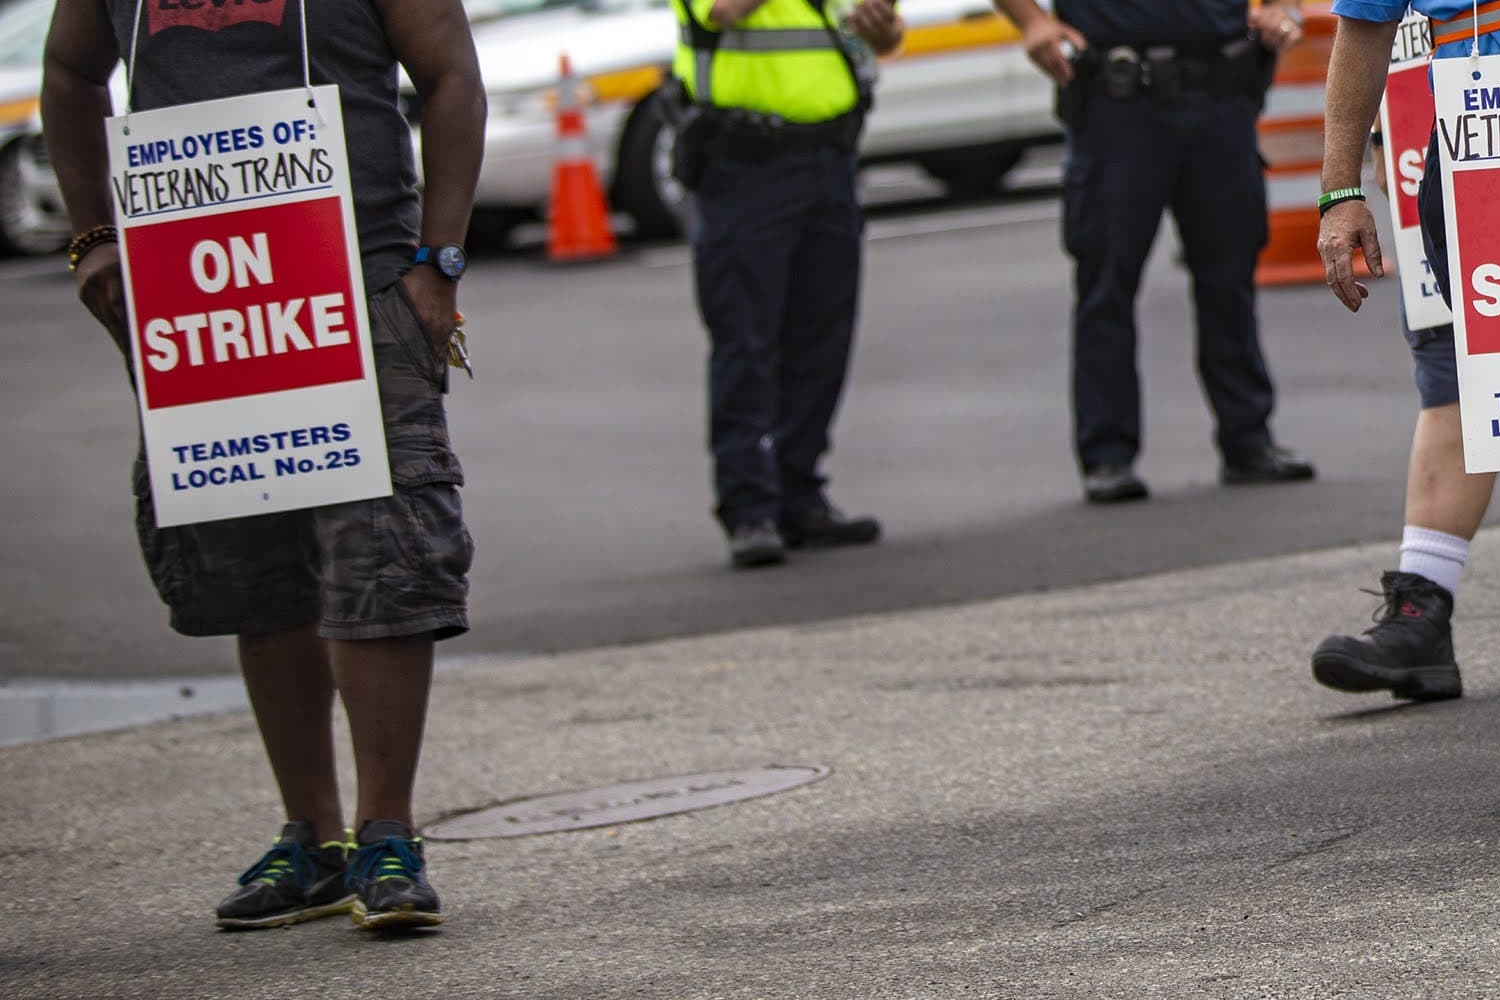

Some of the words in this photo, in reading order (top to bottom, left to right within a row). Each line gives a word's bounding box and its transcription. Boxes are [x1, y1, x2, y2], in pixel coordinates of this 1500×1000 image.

[127, 126, 264, 168] EMPLOYEES
[273, 119, 316, 145] OF:
[113, 163, 230, 216] VETERANS
[232, 148, 334, 194] TRANS
[190, 232, 274, 294] ON
[144, 292, 351, 372] STRIKE
[171, 462, 266, 491] LOCAL
[274, 448, 361, 477] No.25
[172, 423, 352, 464] TEAMSTERS
